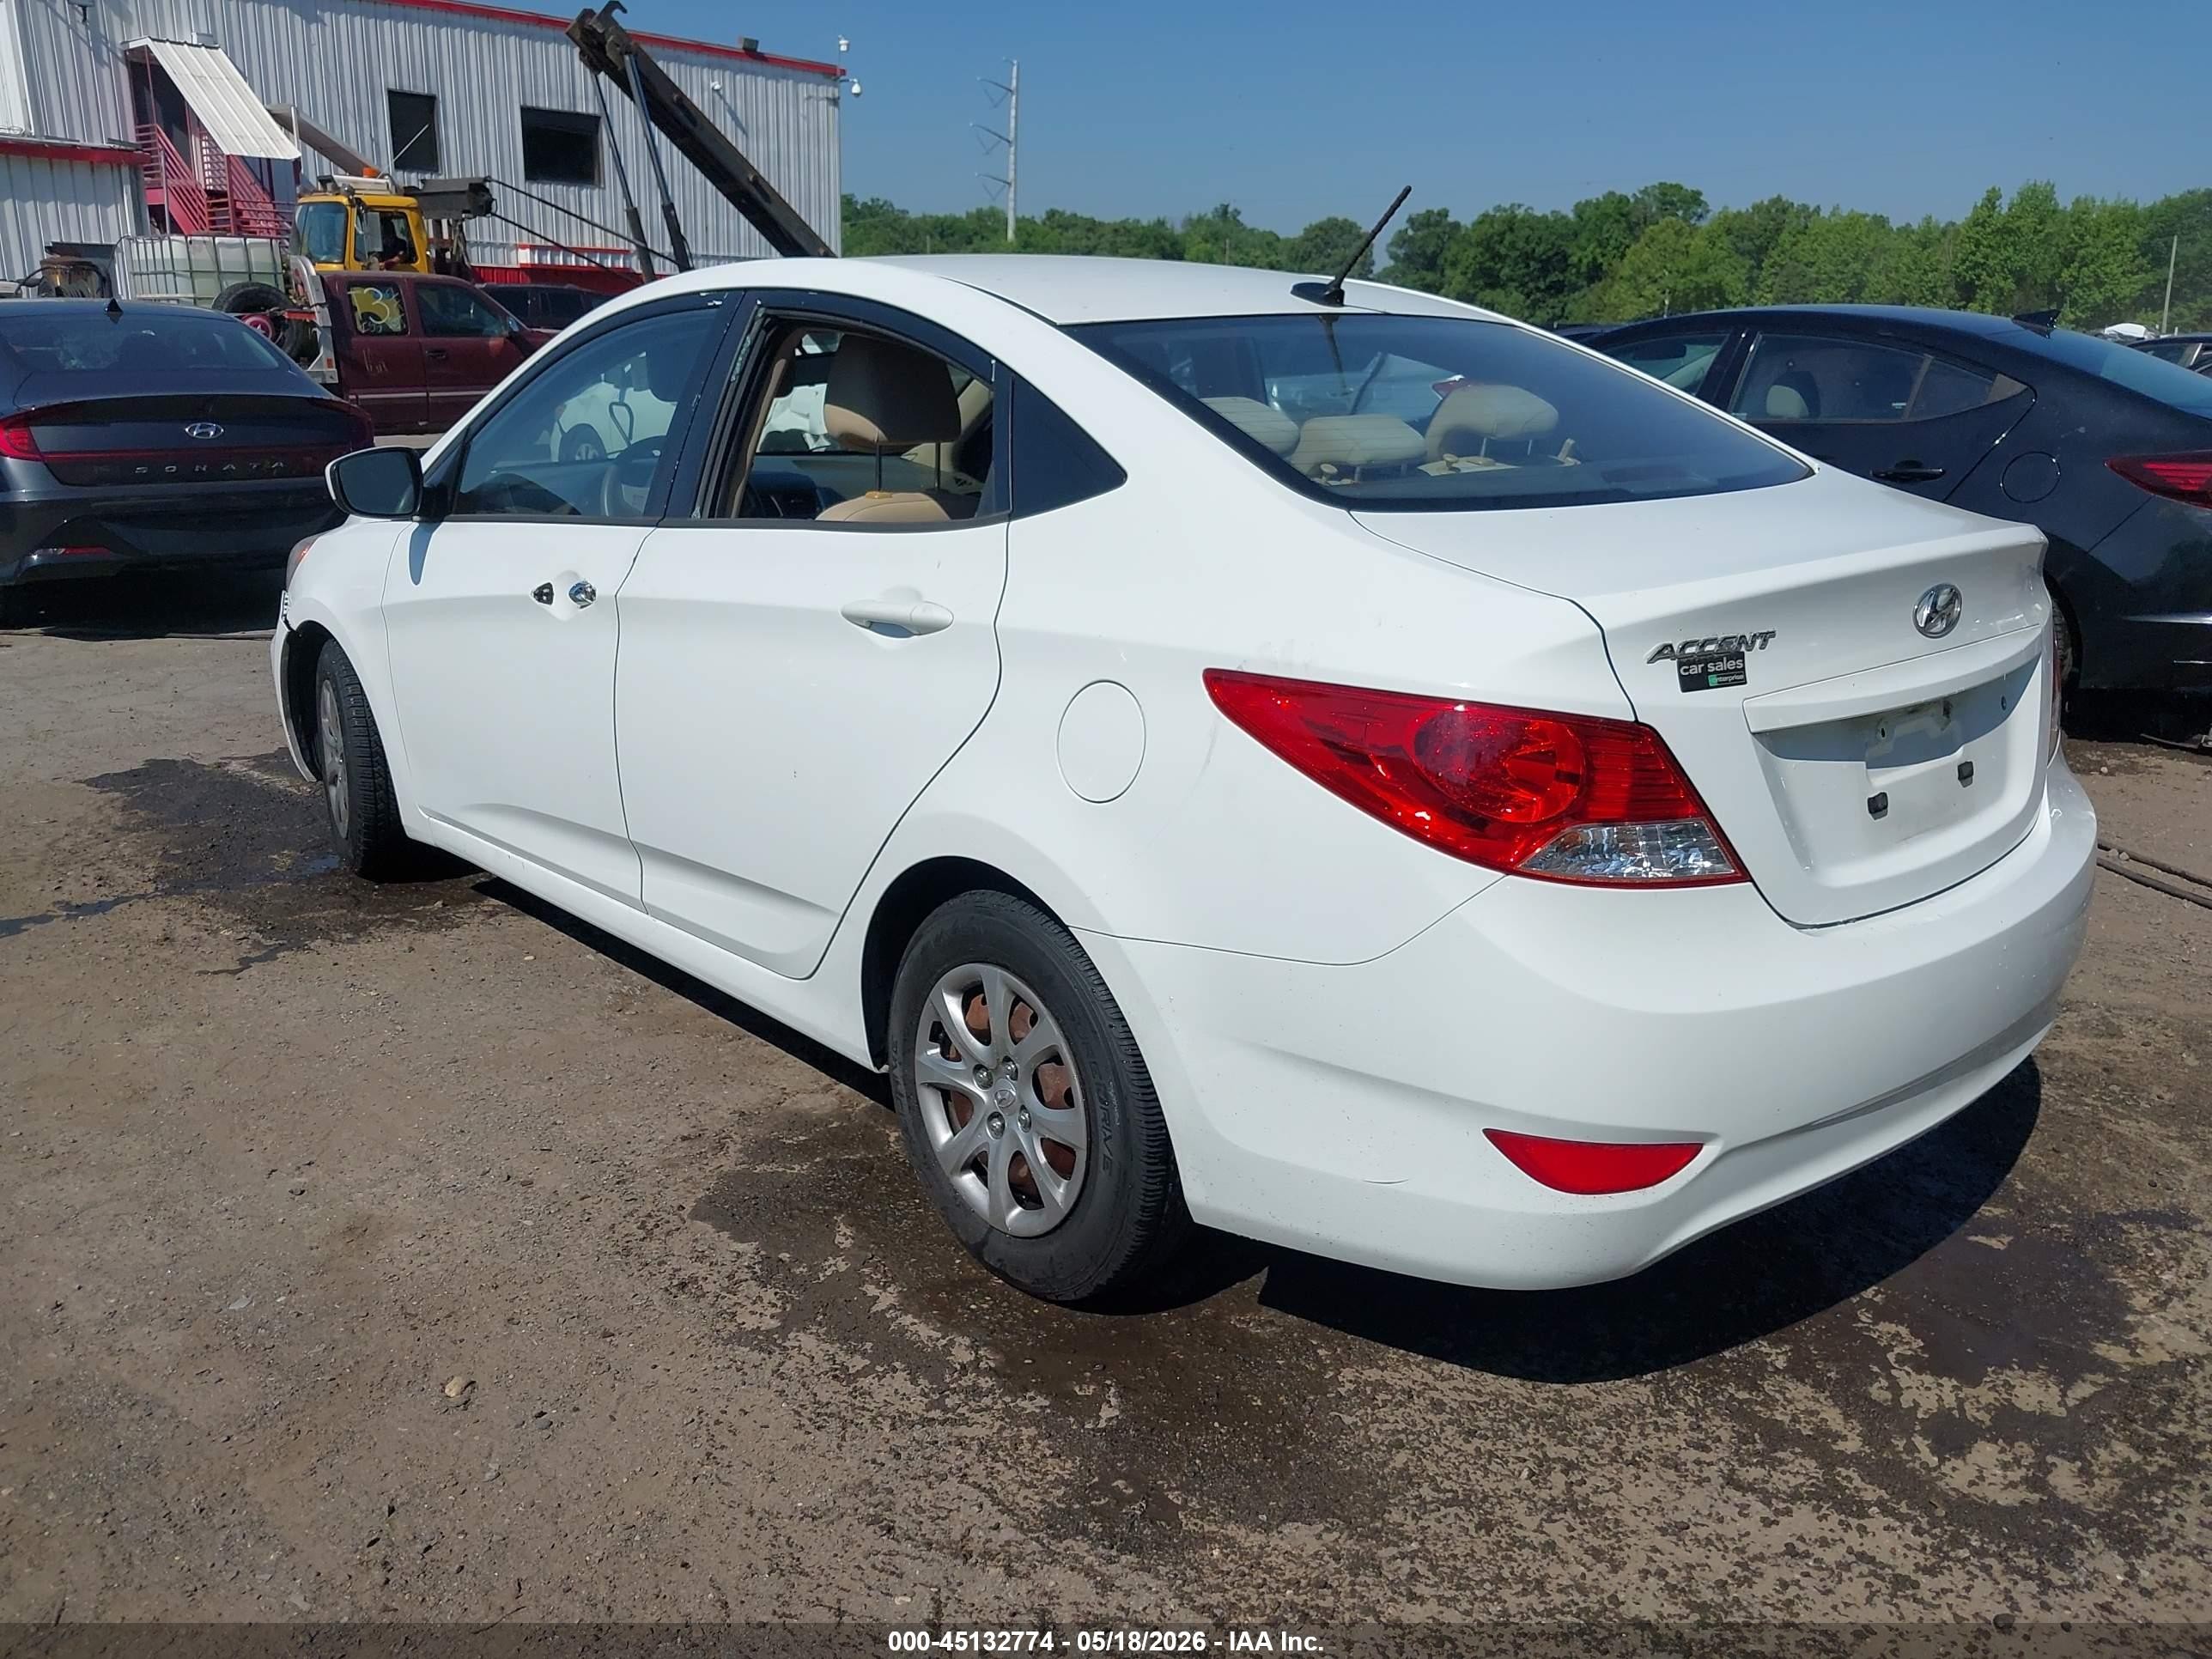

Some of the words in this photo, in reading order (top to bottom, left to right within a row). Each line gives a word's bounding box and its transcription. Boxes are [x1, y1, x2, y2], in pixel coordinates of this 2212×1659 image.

[134, 461, 284, 474] SONATA
[1647, 630, 1778, 664] ACCENT
[1680, 663, 1705, 676] car
[1707, 656, 1744, 672] sales
